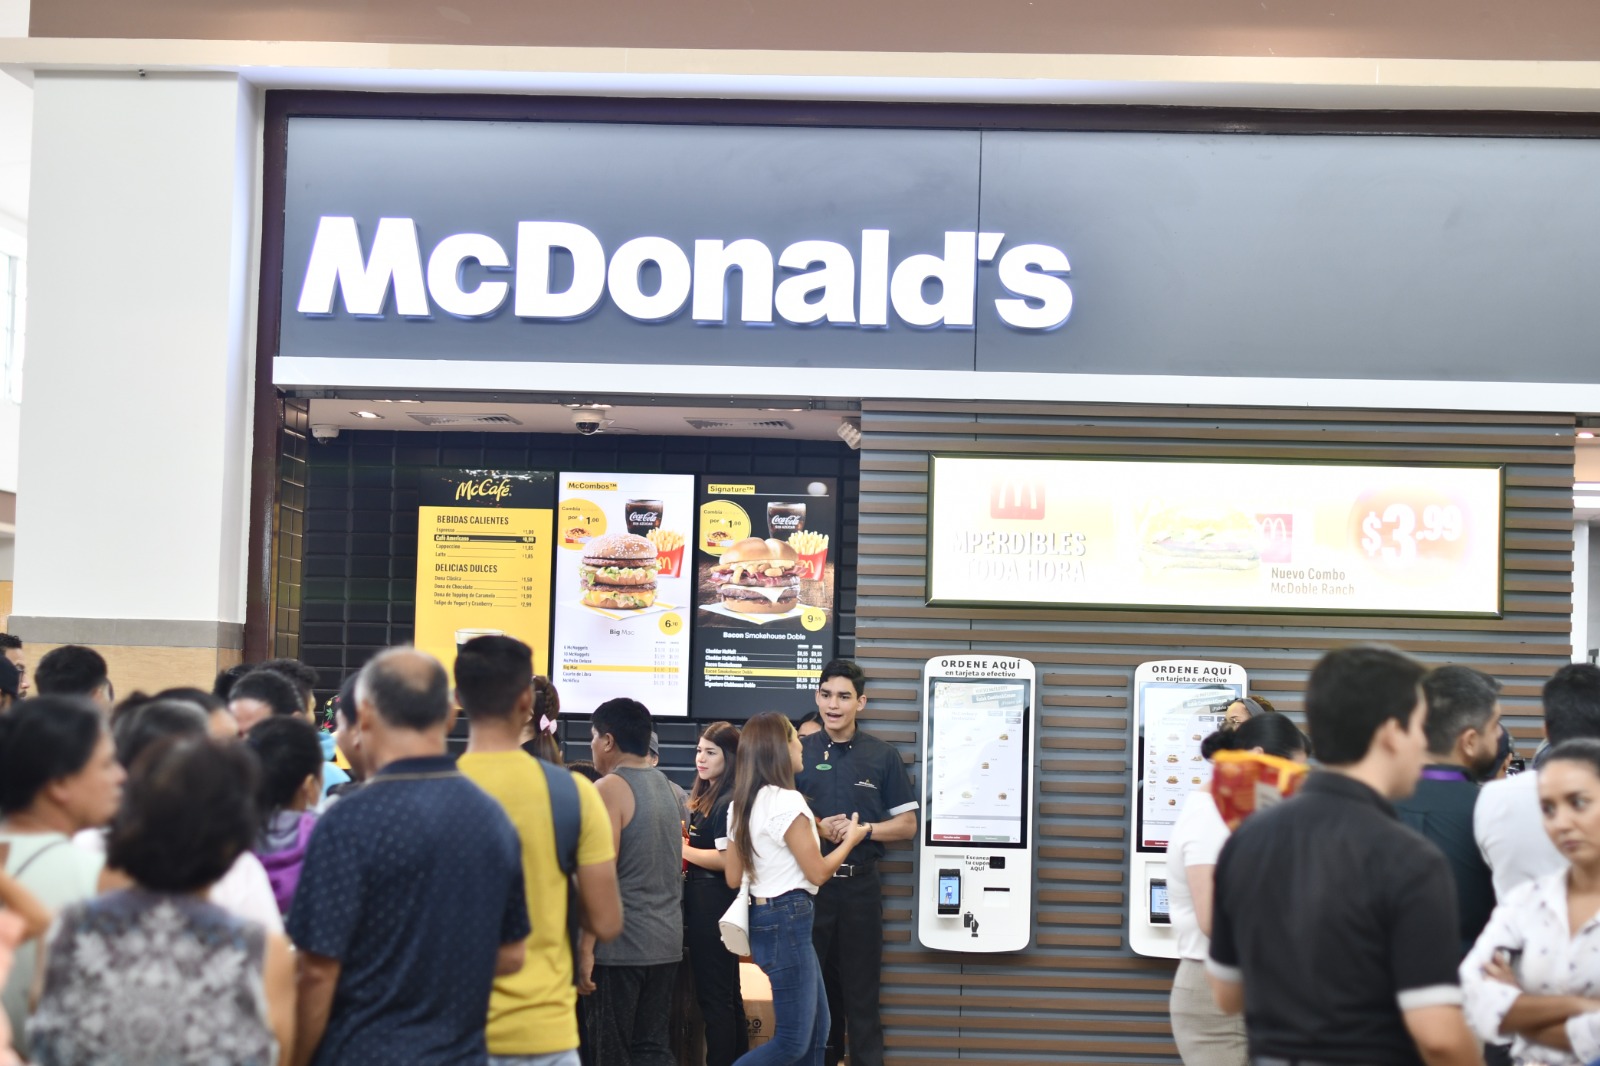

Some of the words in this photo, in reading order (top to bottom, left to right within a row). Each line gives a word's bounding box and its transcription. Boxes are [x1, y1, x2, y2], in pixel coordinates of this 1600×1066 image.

[297, 216, 1074, 330] McDonald's
[437, 515, 468, 524] BEBIDAS
[470, 516, 509, 525] CALIENTES
[1362, 503, 1463, 568] $3.99
[435, 564, 468, 572] DELICIAS
[470, 564, 498, 573] DULCES
[1271, 568, 1305, 580] Nuevo
[1308, 568, 1346, 581] Combo
[1271, 582, 1318, 595] McDoble
[1322, 584, 1355, 596] Ranch
[941, 660, 988, 669] ORDENE
[992, 659, 1021, 670] AQUÍ
[1152, 665, 1199, 674] ORDENE
[1203, 665, 1232, 676] AQUÍ
